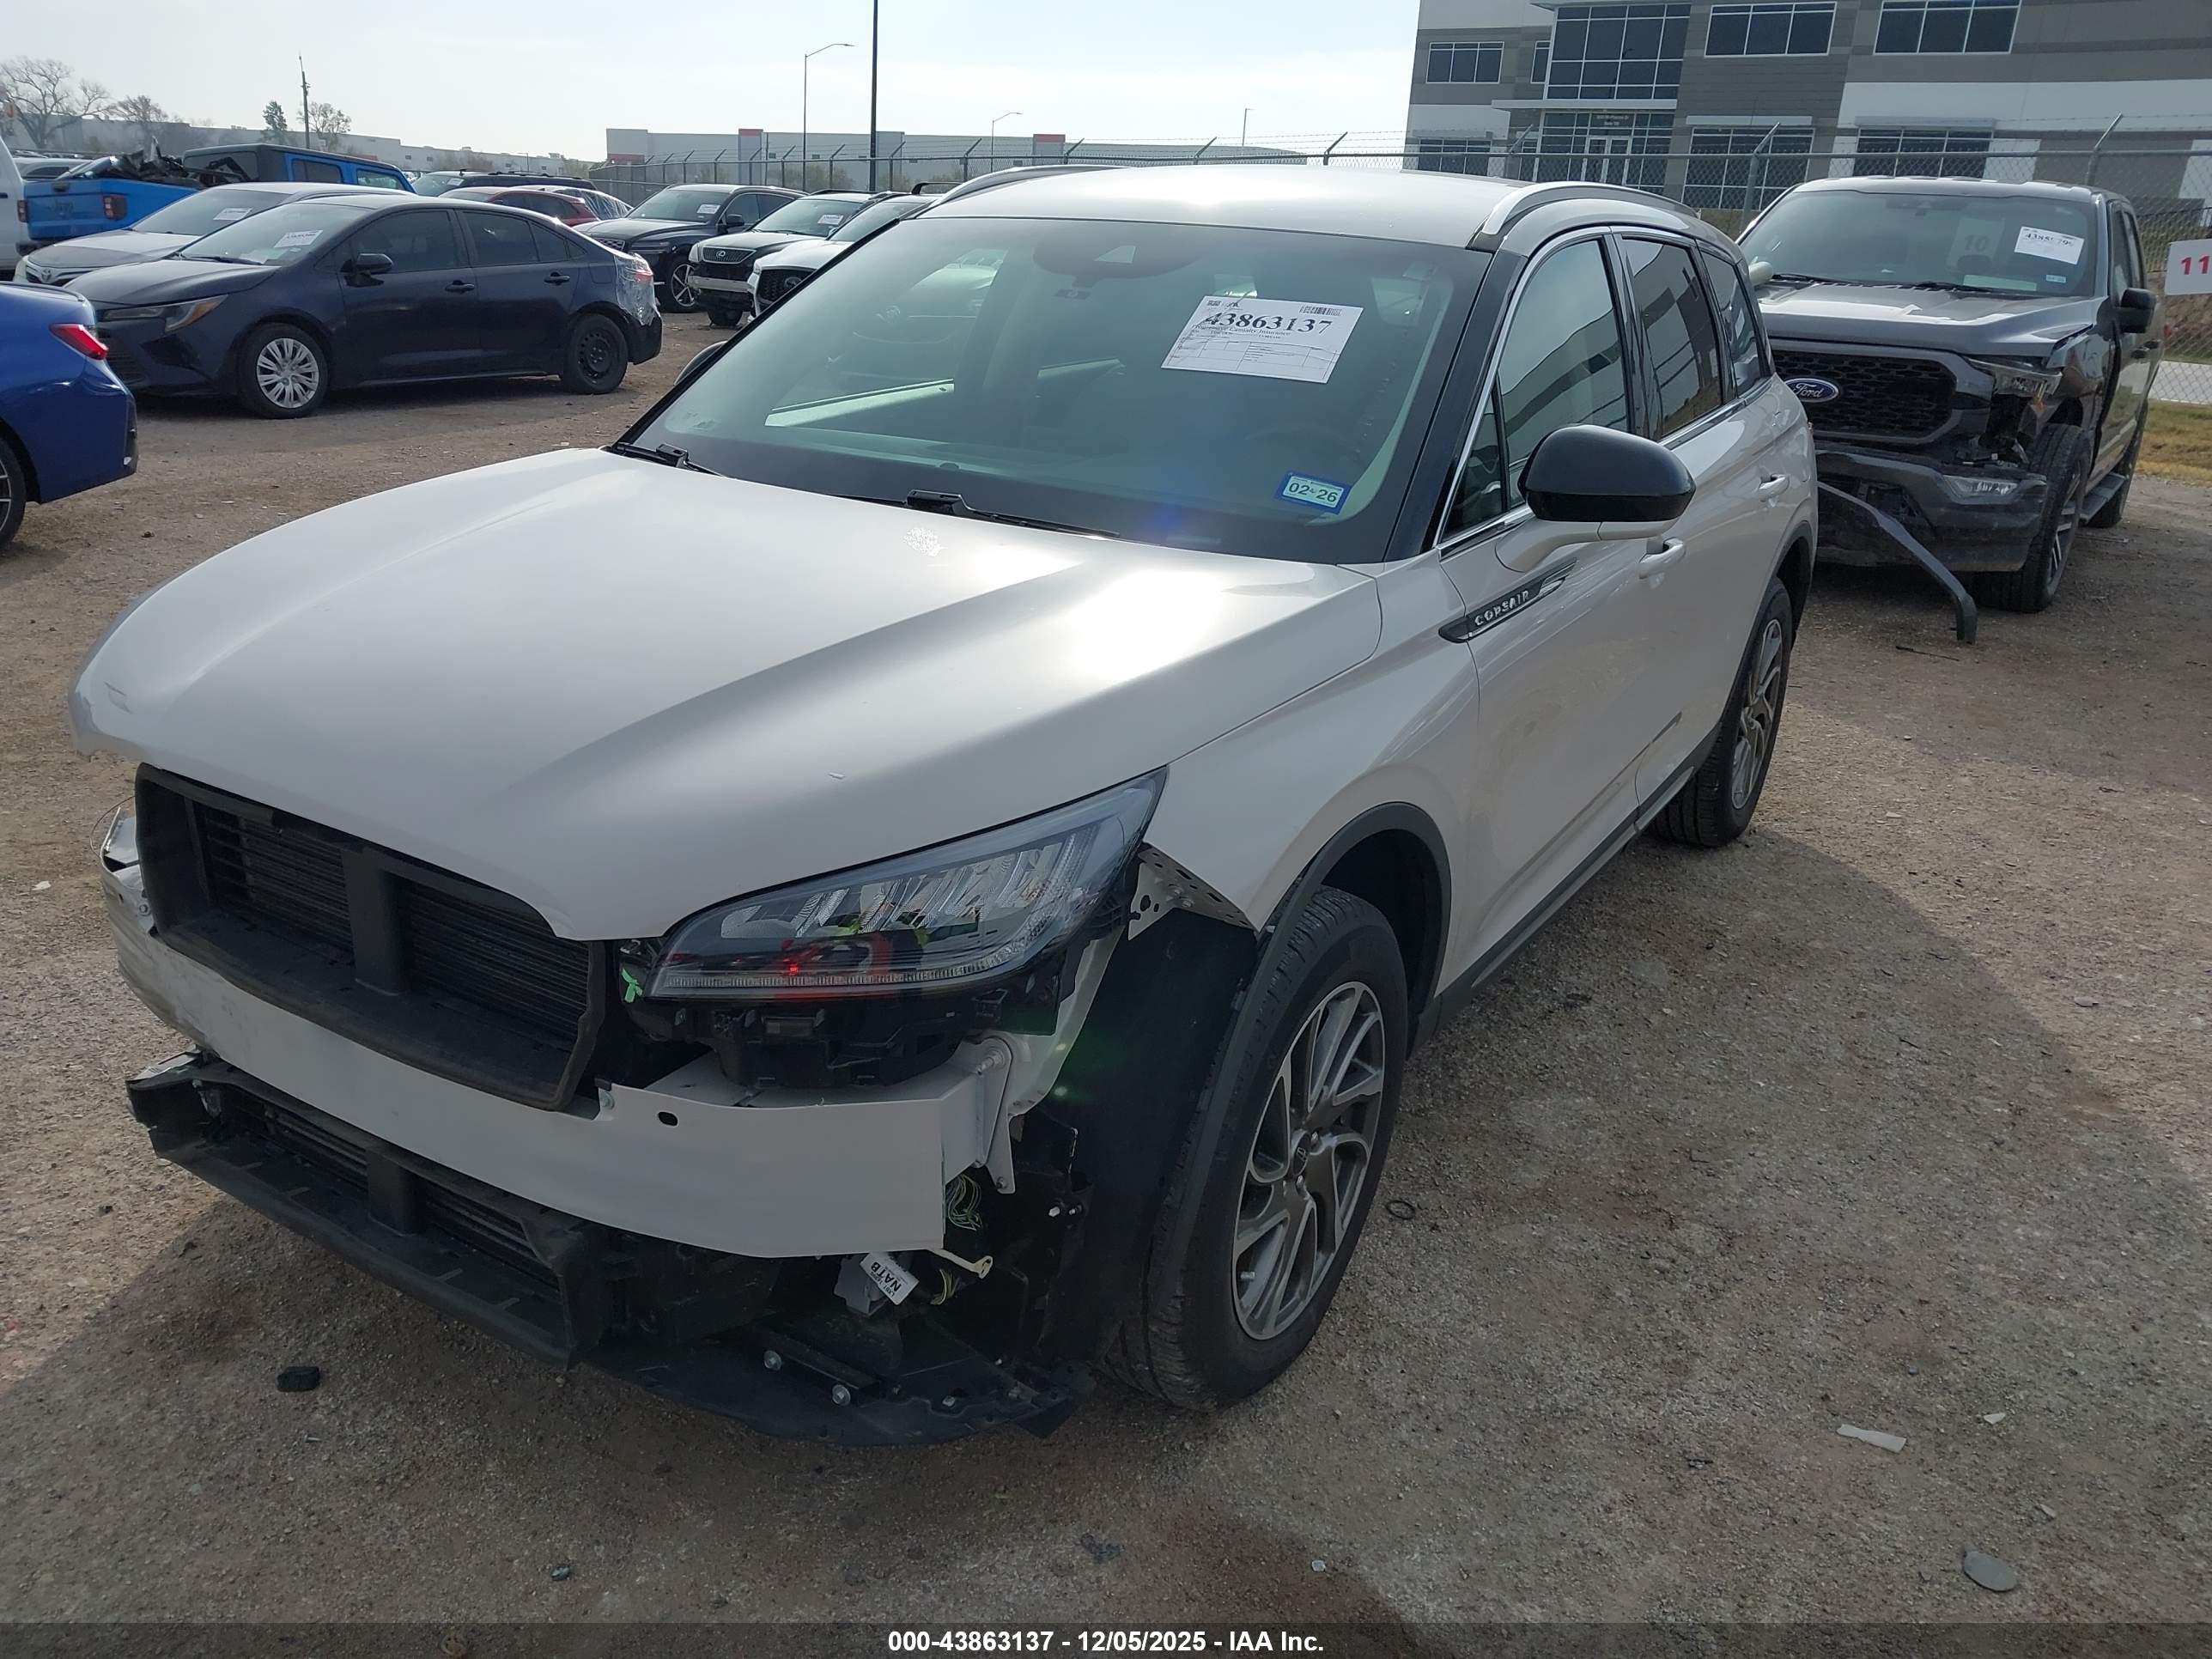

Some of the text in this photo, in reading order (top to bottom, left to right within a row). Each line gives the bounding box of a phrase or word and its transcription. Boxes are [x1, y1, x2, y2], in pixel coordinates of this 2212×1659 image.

[1205, 312, 1333, 334] 43863137
[1793, 383, 1824, 397] Ford
[1289, 483, 1339, 502] 02 26
[1474, 590, 1529, 626] CORSAIR
[871, 1261, 902, 1292] NATB
